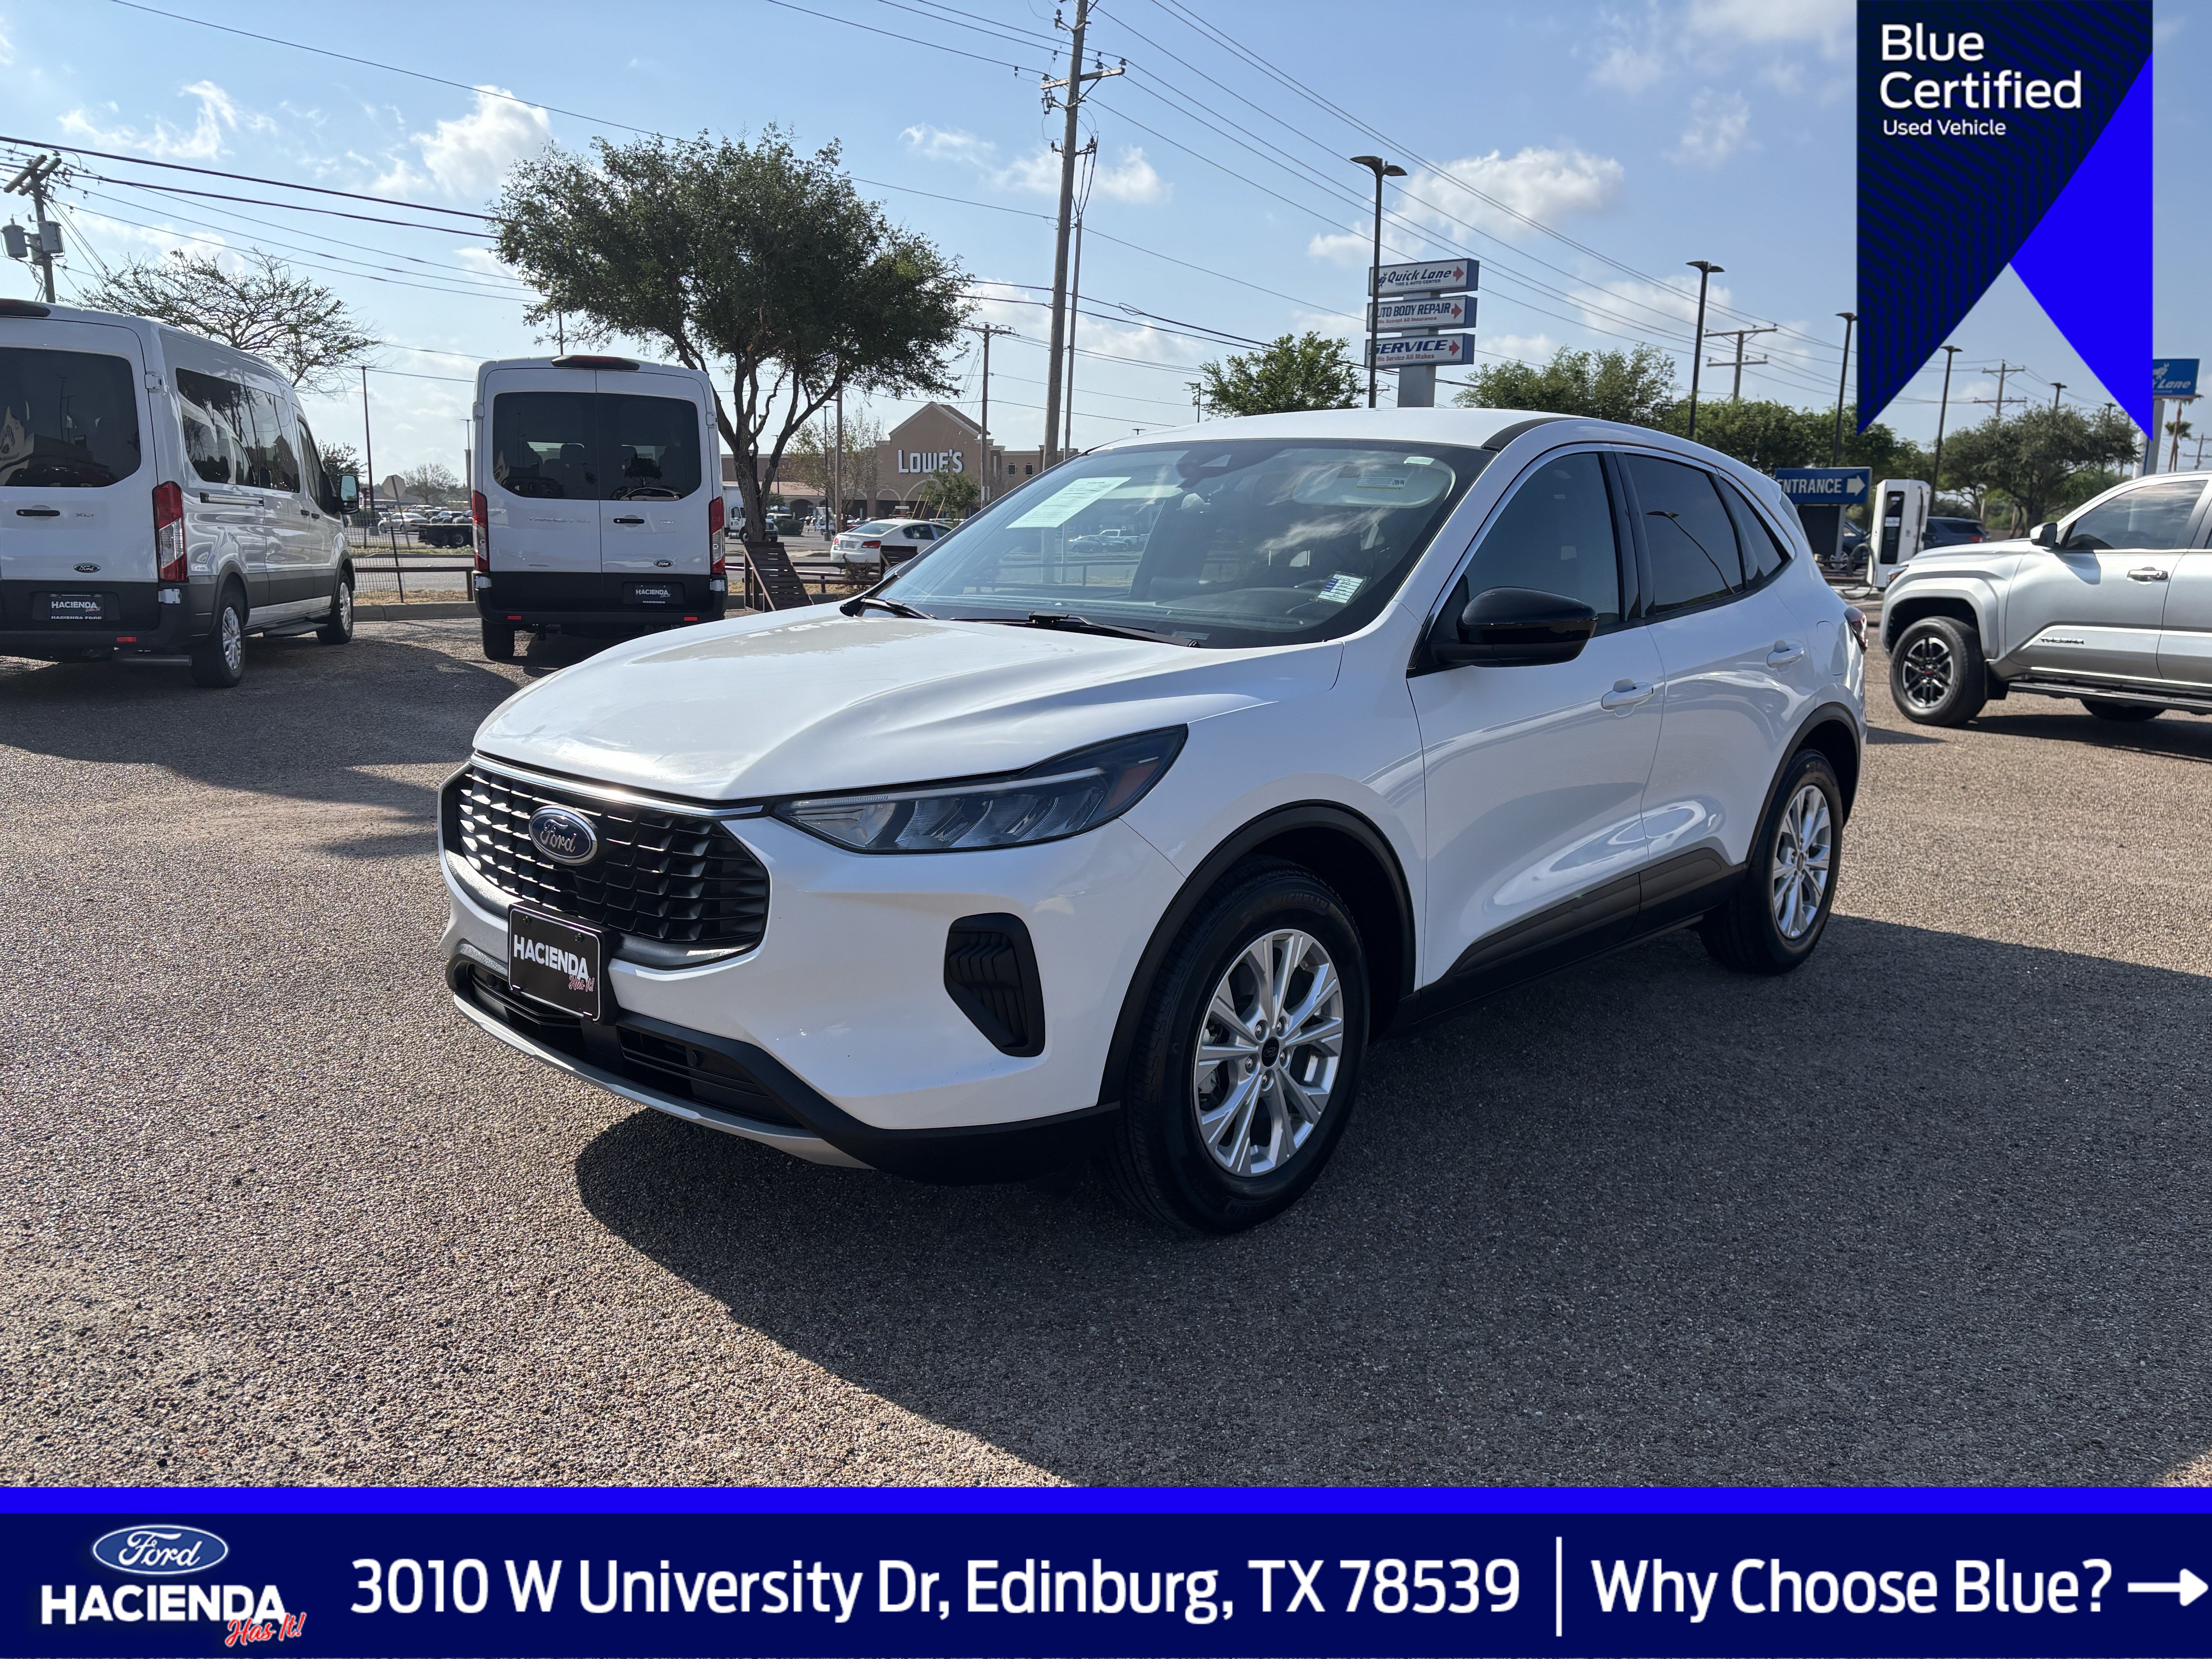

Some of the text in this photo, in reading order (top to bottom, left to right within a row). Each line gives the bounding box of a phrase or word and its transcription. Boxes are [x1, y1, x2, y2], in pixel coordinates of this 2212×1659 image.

[1388, 269, 1452, 283] Quick Lane
[1370, 303, 1451, 317] UTO BODY REPAIR
[898, 449, 963, 473] LOWE'S
[540, 819, 577, 852] Ford
[514, 934, 588, 981] HACIENDA
